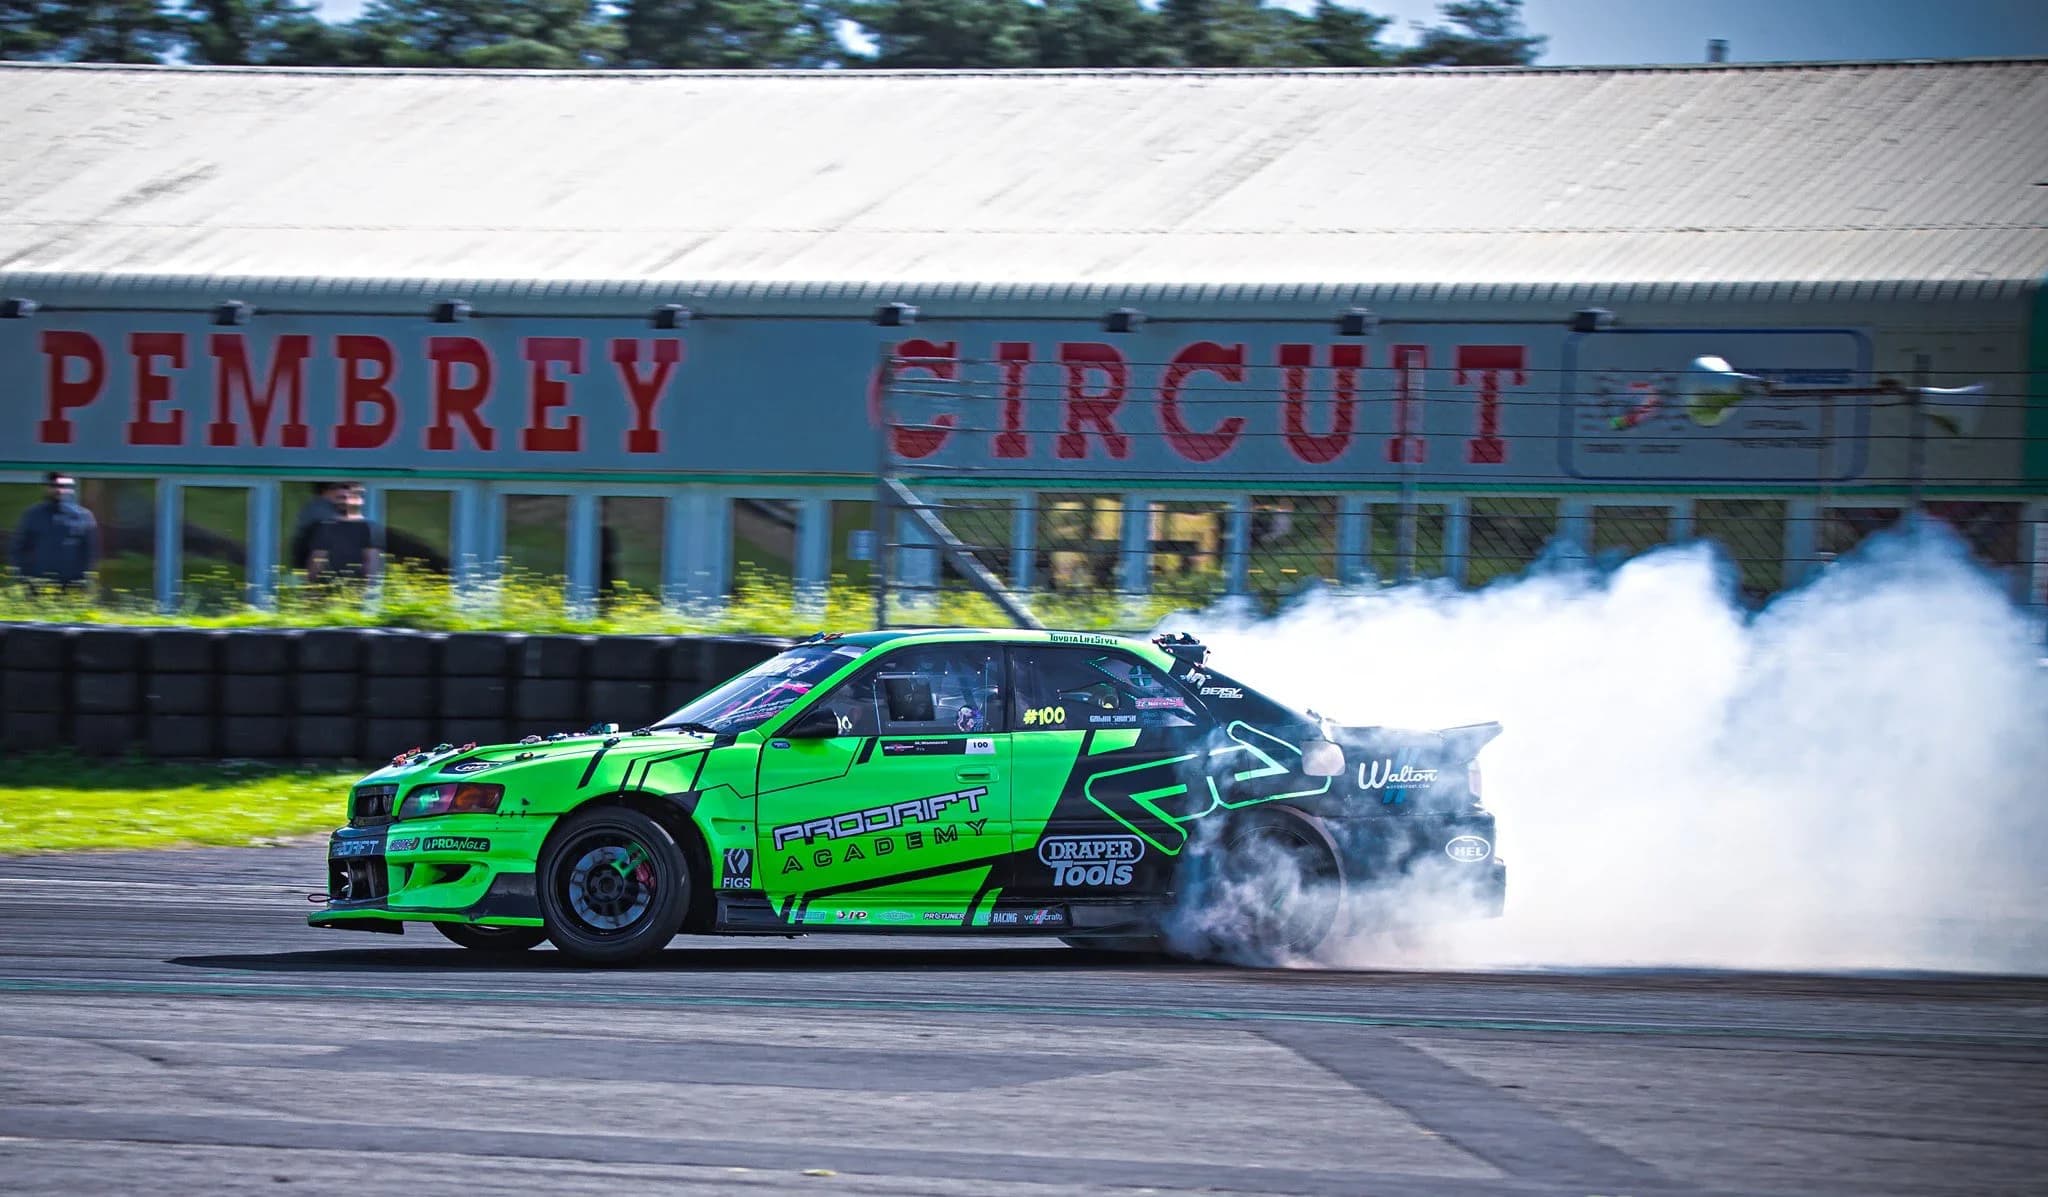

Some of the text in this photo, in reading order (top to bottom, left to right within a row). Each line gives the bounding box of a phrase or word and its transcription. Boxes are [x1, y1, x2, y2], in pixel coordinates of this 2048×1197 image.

[38, 330, 1528, 465] PEMBREY CIRCUIT
[1023, 706, 1066, 726] #100
[972, 741, 989, 749] 100
[1358, 759, 1438, 790] Walton
[772, 786, 988, 851] PRODRIFT
[431, 837, 488, 851] PROANGLE
[782, 818, 988, 874] ACADEMY
[1049, 840, 1135, 861] DRAPER
[1453, 846, 1483, 857] HEL
[722, 877, 751, 889] FIGS
[1049, 860, 1133, 887] Tools
[993, 912, 1018, 923] RACING
